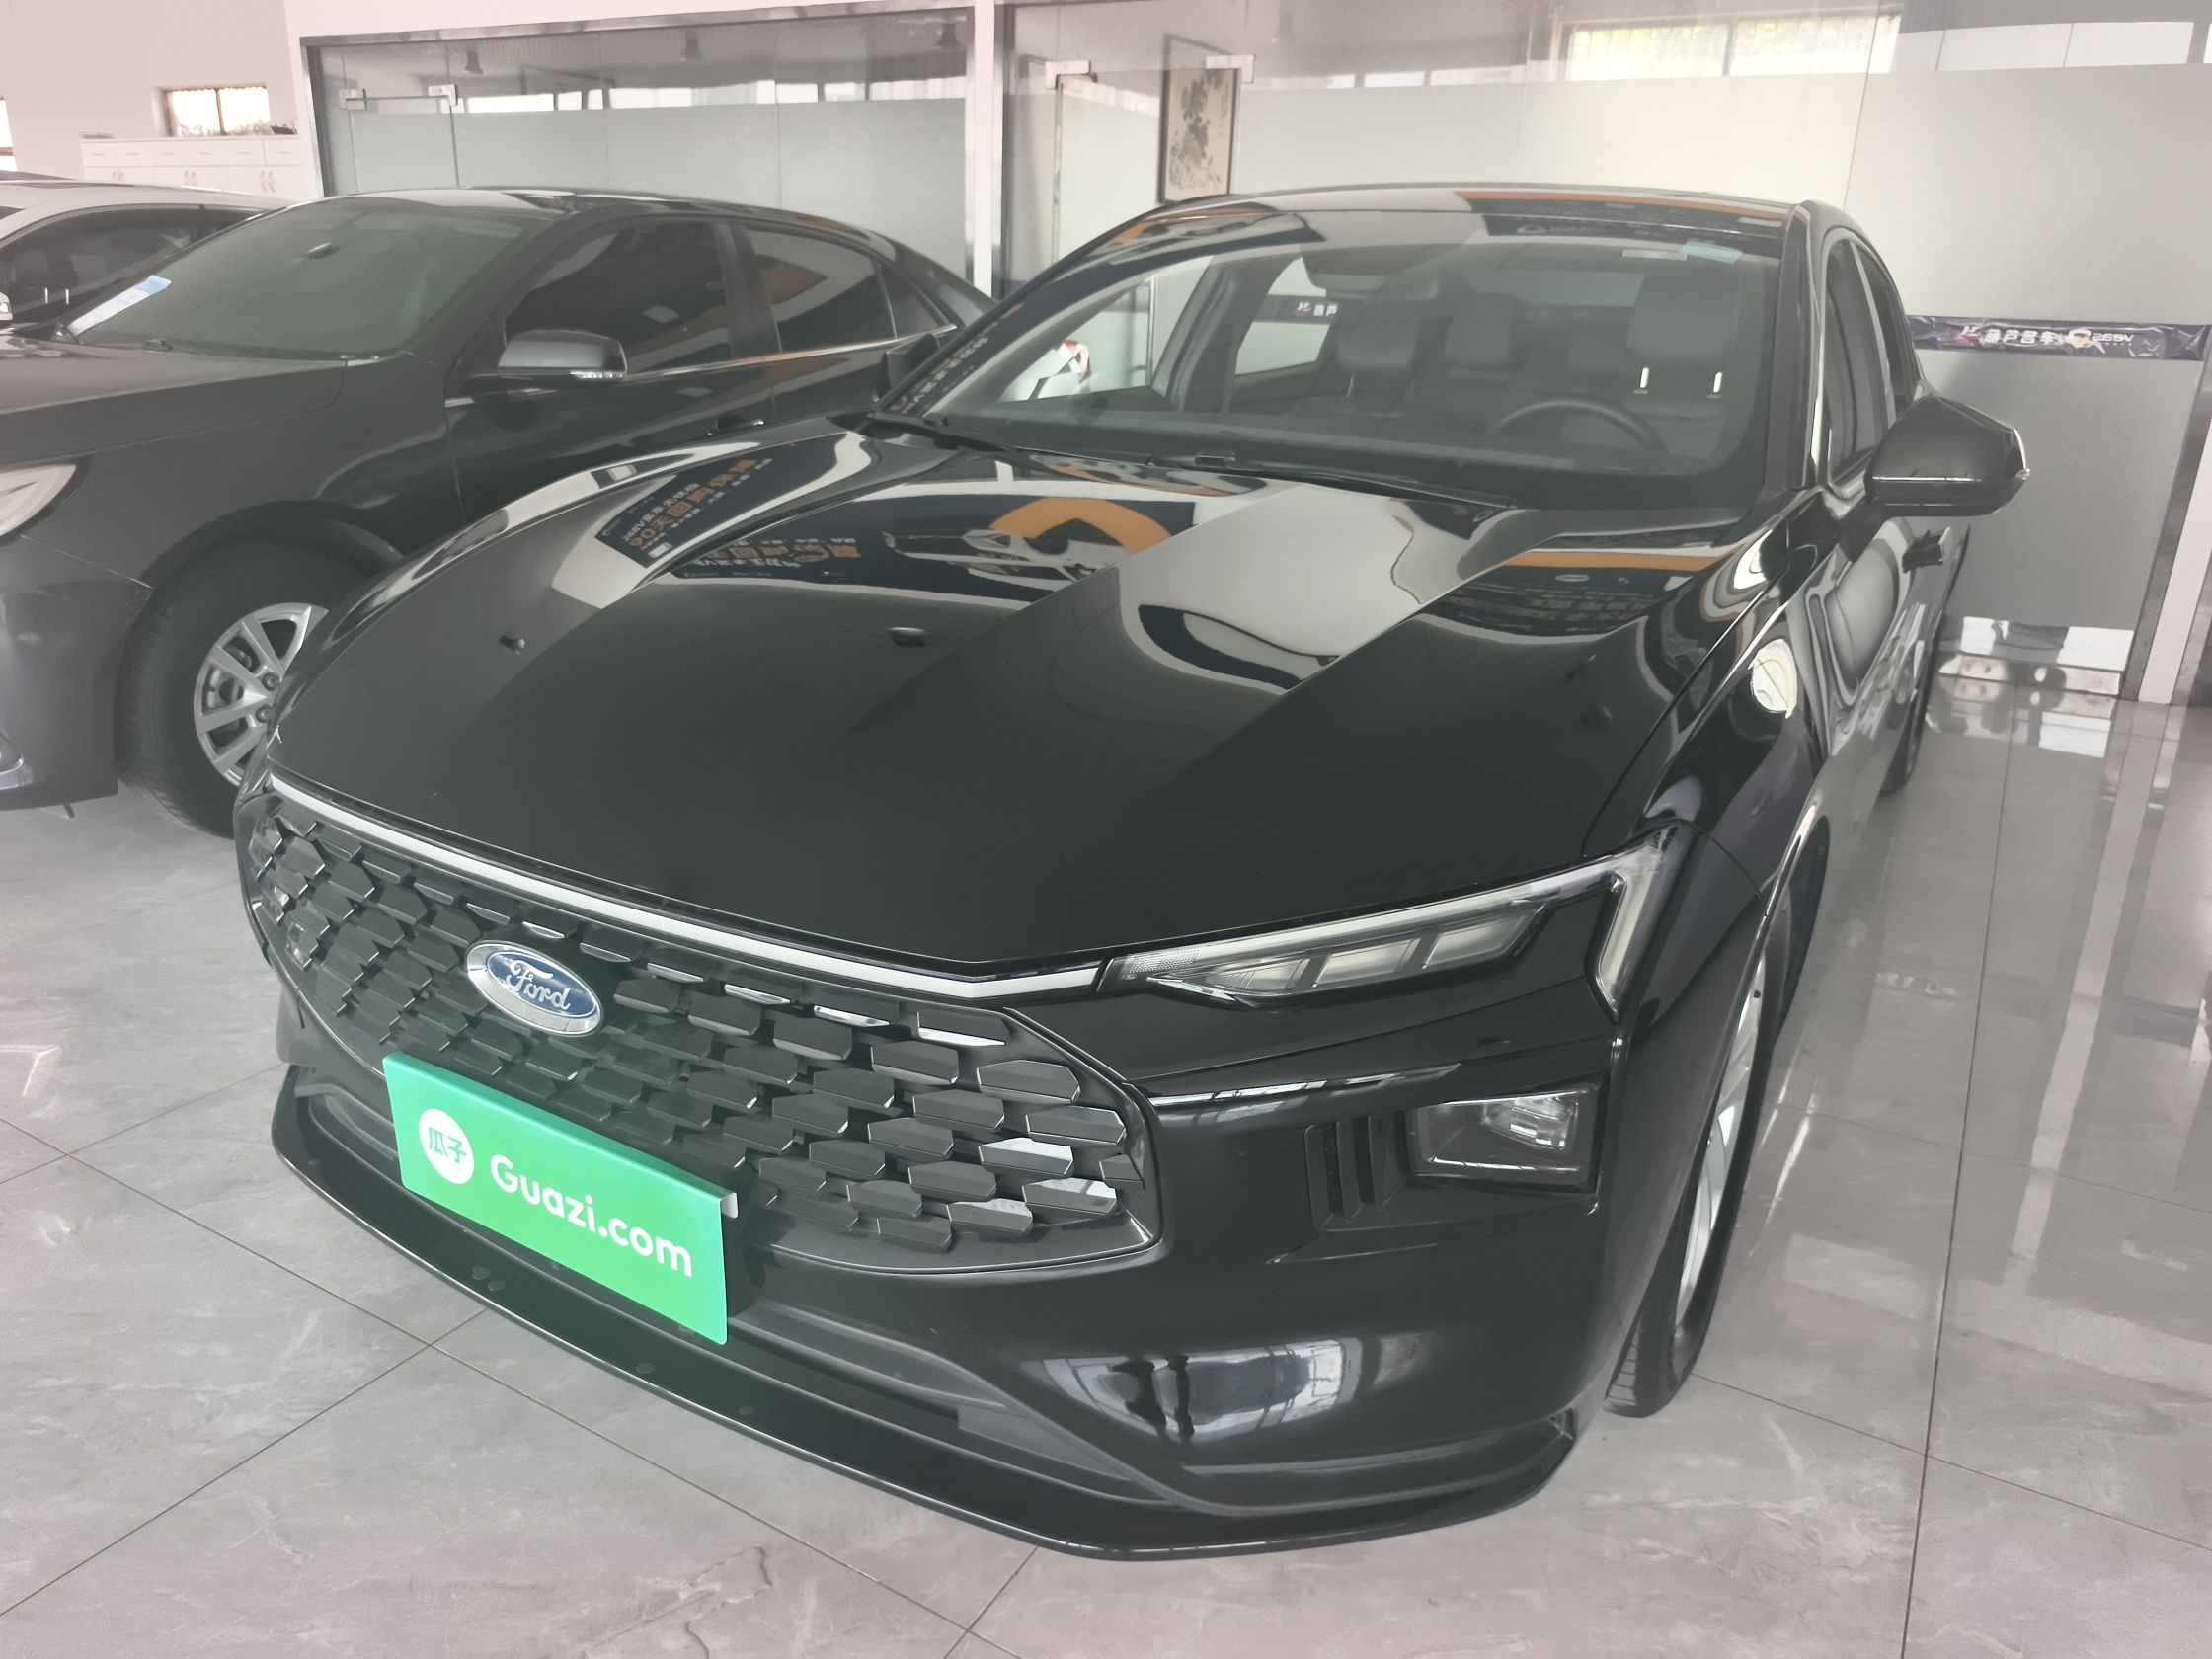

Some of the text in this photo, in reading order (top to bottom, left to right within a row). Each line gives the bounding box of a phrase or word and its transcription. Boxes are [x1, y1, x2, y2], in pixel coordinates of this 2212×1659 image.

[506, 959, 571, 1010] Ford
[427, 1127, 467, 1164] 瓜子
[490, 1153, 693, 1278] Guazi.com
